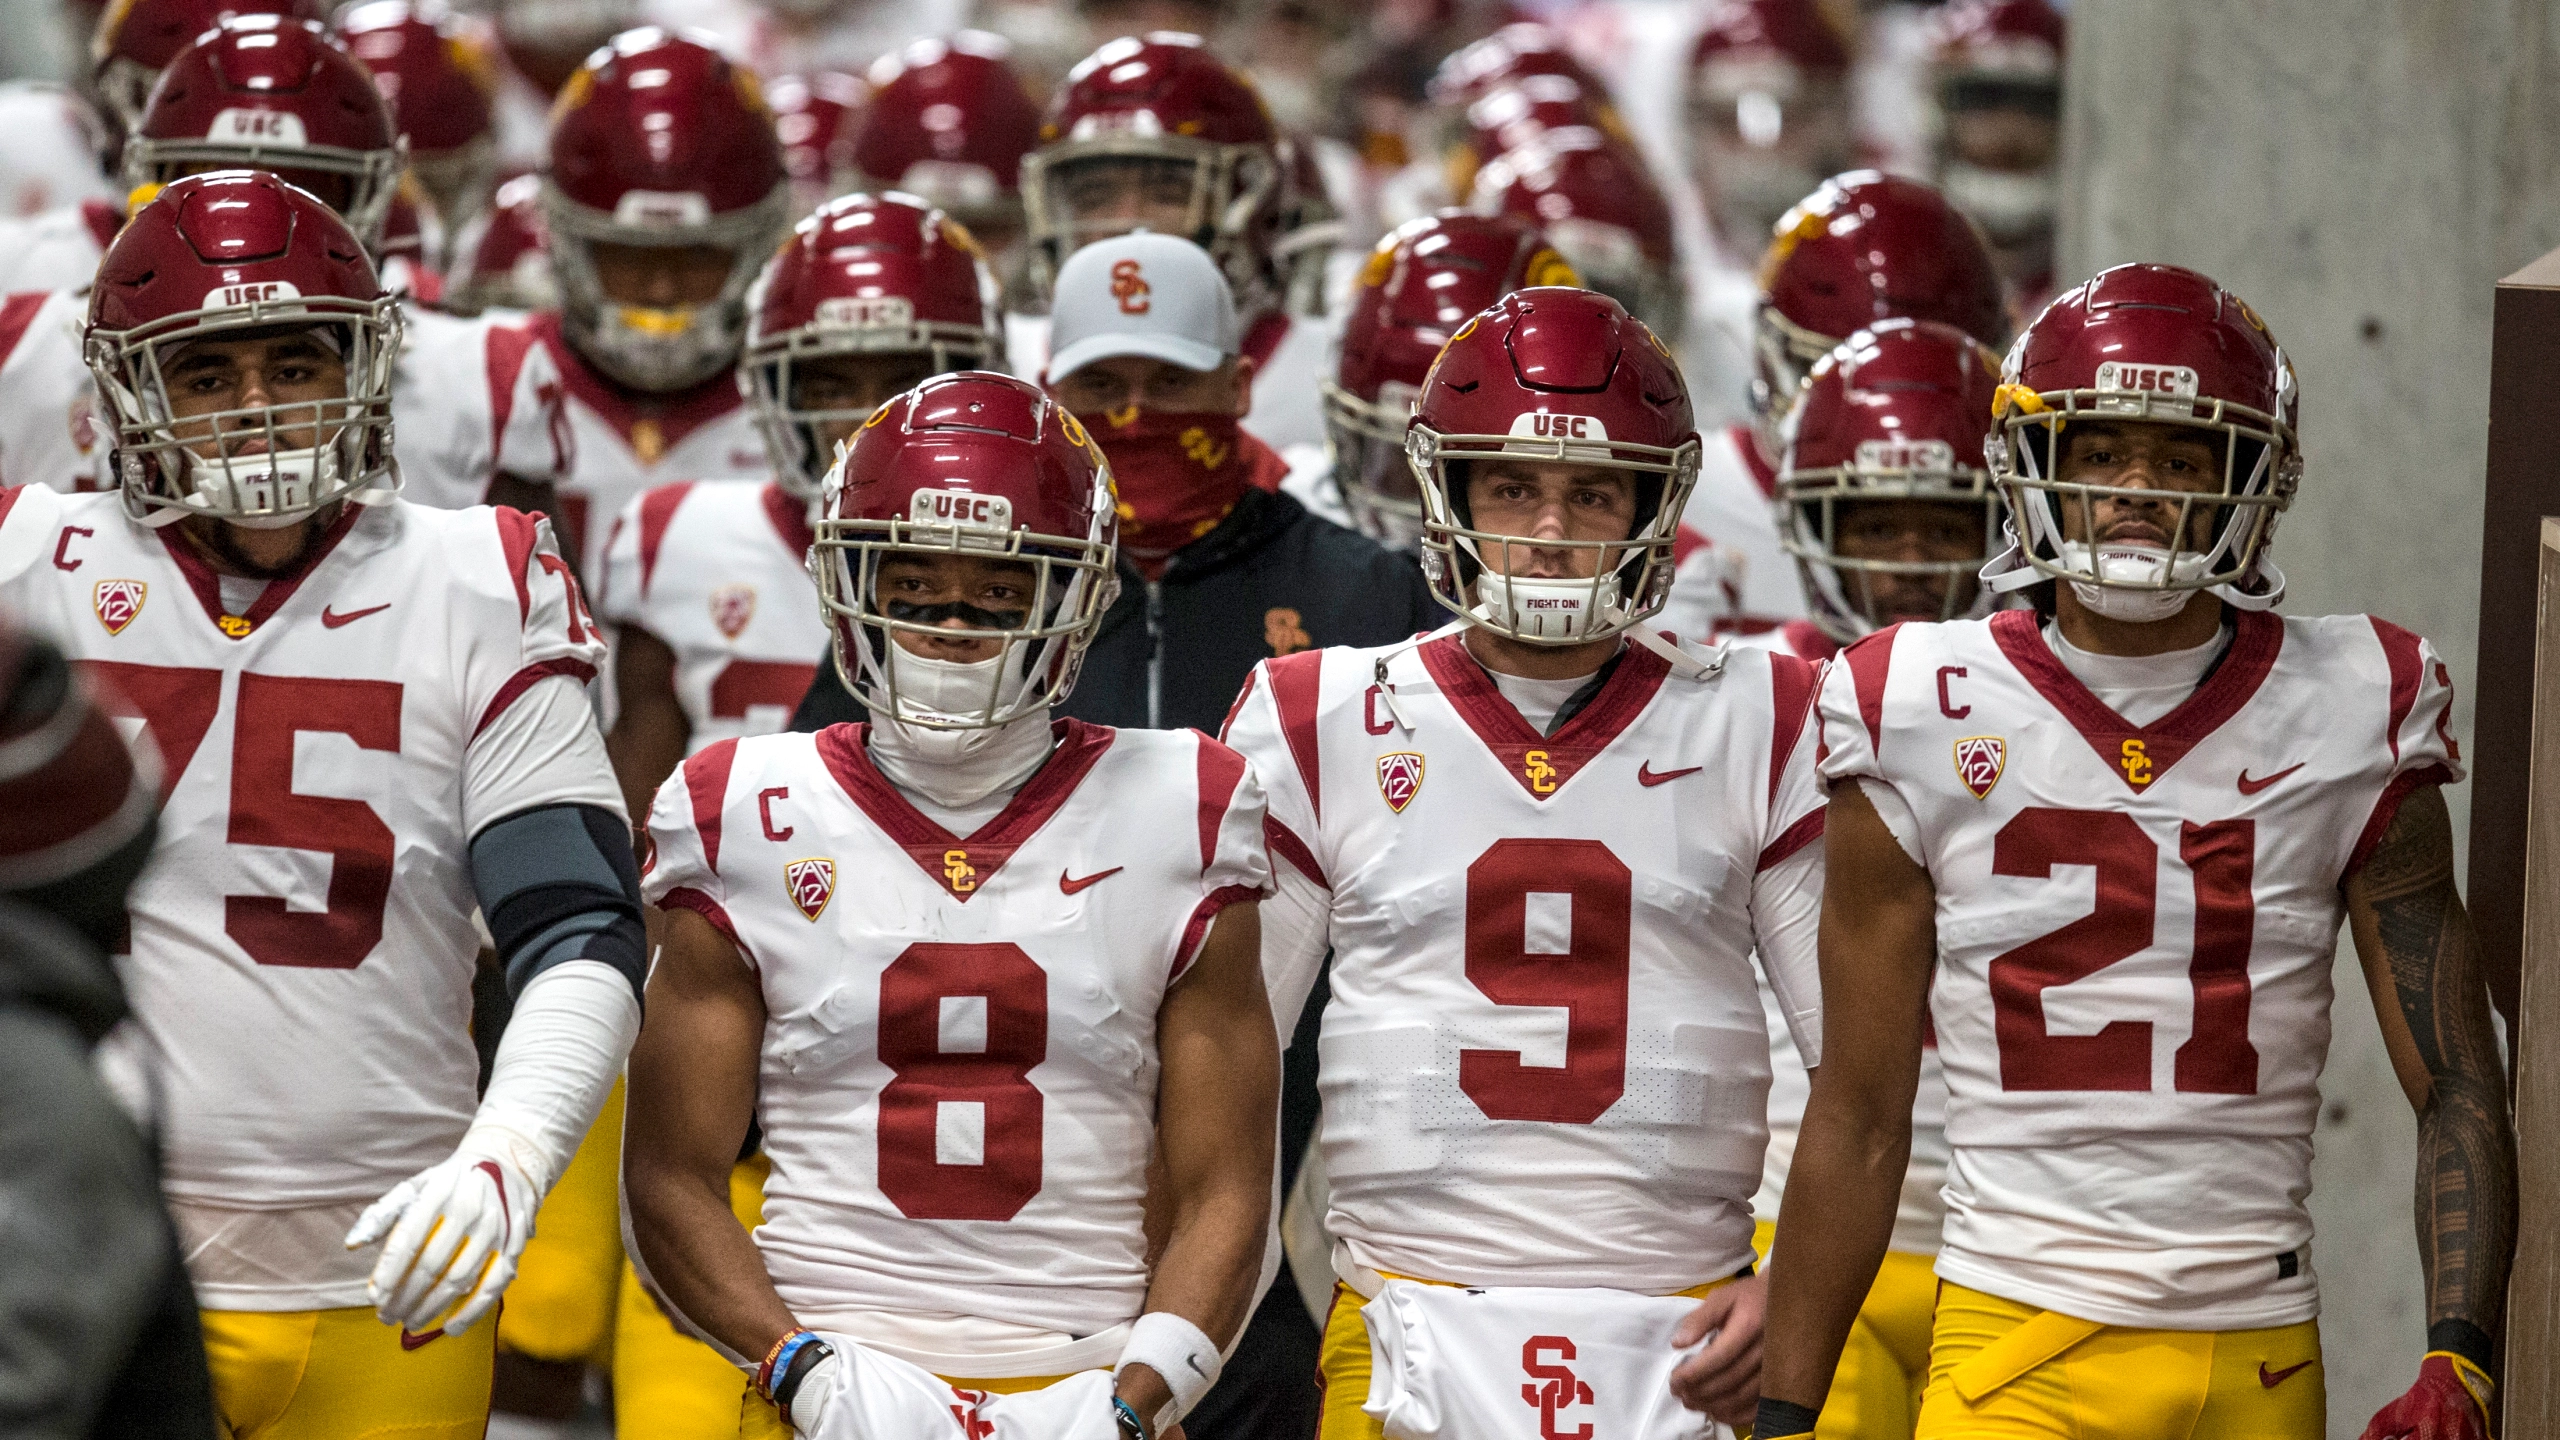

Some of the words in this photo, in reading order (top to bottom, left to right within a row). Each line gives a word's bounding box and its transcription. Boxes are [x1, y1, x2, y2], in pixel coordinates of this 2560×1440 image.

[224, 284, 279, 306] USC
[1110, 258, 1151, 316] SC
[2120, 368, 2175, 393] USC
[1533, 414, 1587, 439] USC
[935, 495, 989, 523] USC
[53, 525, 95, 572] C
[97, 579, 144, 611] PAC
[103, 600, 129, 622] 12
[1527, 599, 1559, 609] FIGHT
[1561, 599, 1580, 609] ON!
[1364, 684, 1396, 736] C
[1936, 666, 1971, 720] C
[1379, 754, 1421, 790] PAC
[1525, 750, 1556, 793] SC
[1956, 738, 2003, 775] PAC
[1967, 761, 1993, 786] 12
[2121, 738, 2153, 785] SC
[1387, 776, 1410, 801] 12
[758, 786, 794, 842] C
[787, 859, 832, 897] PAC
[943, 849, 976, 892] SC
[799, 883, 824, 908] 12
[1990, 806, 2260, 1096] 21
[1459, 838, 1632, 1125] 9
[876, 941, 1048, 1222] 8
[1521, 1335, 1594, 1440] SC
